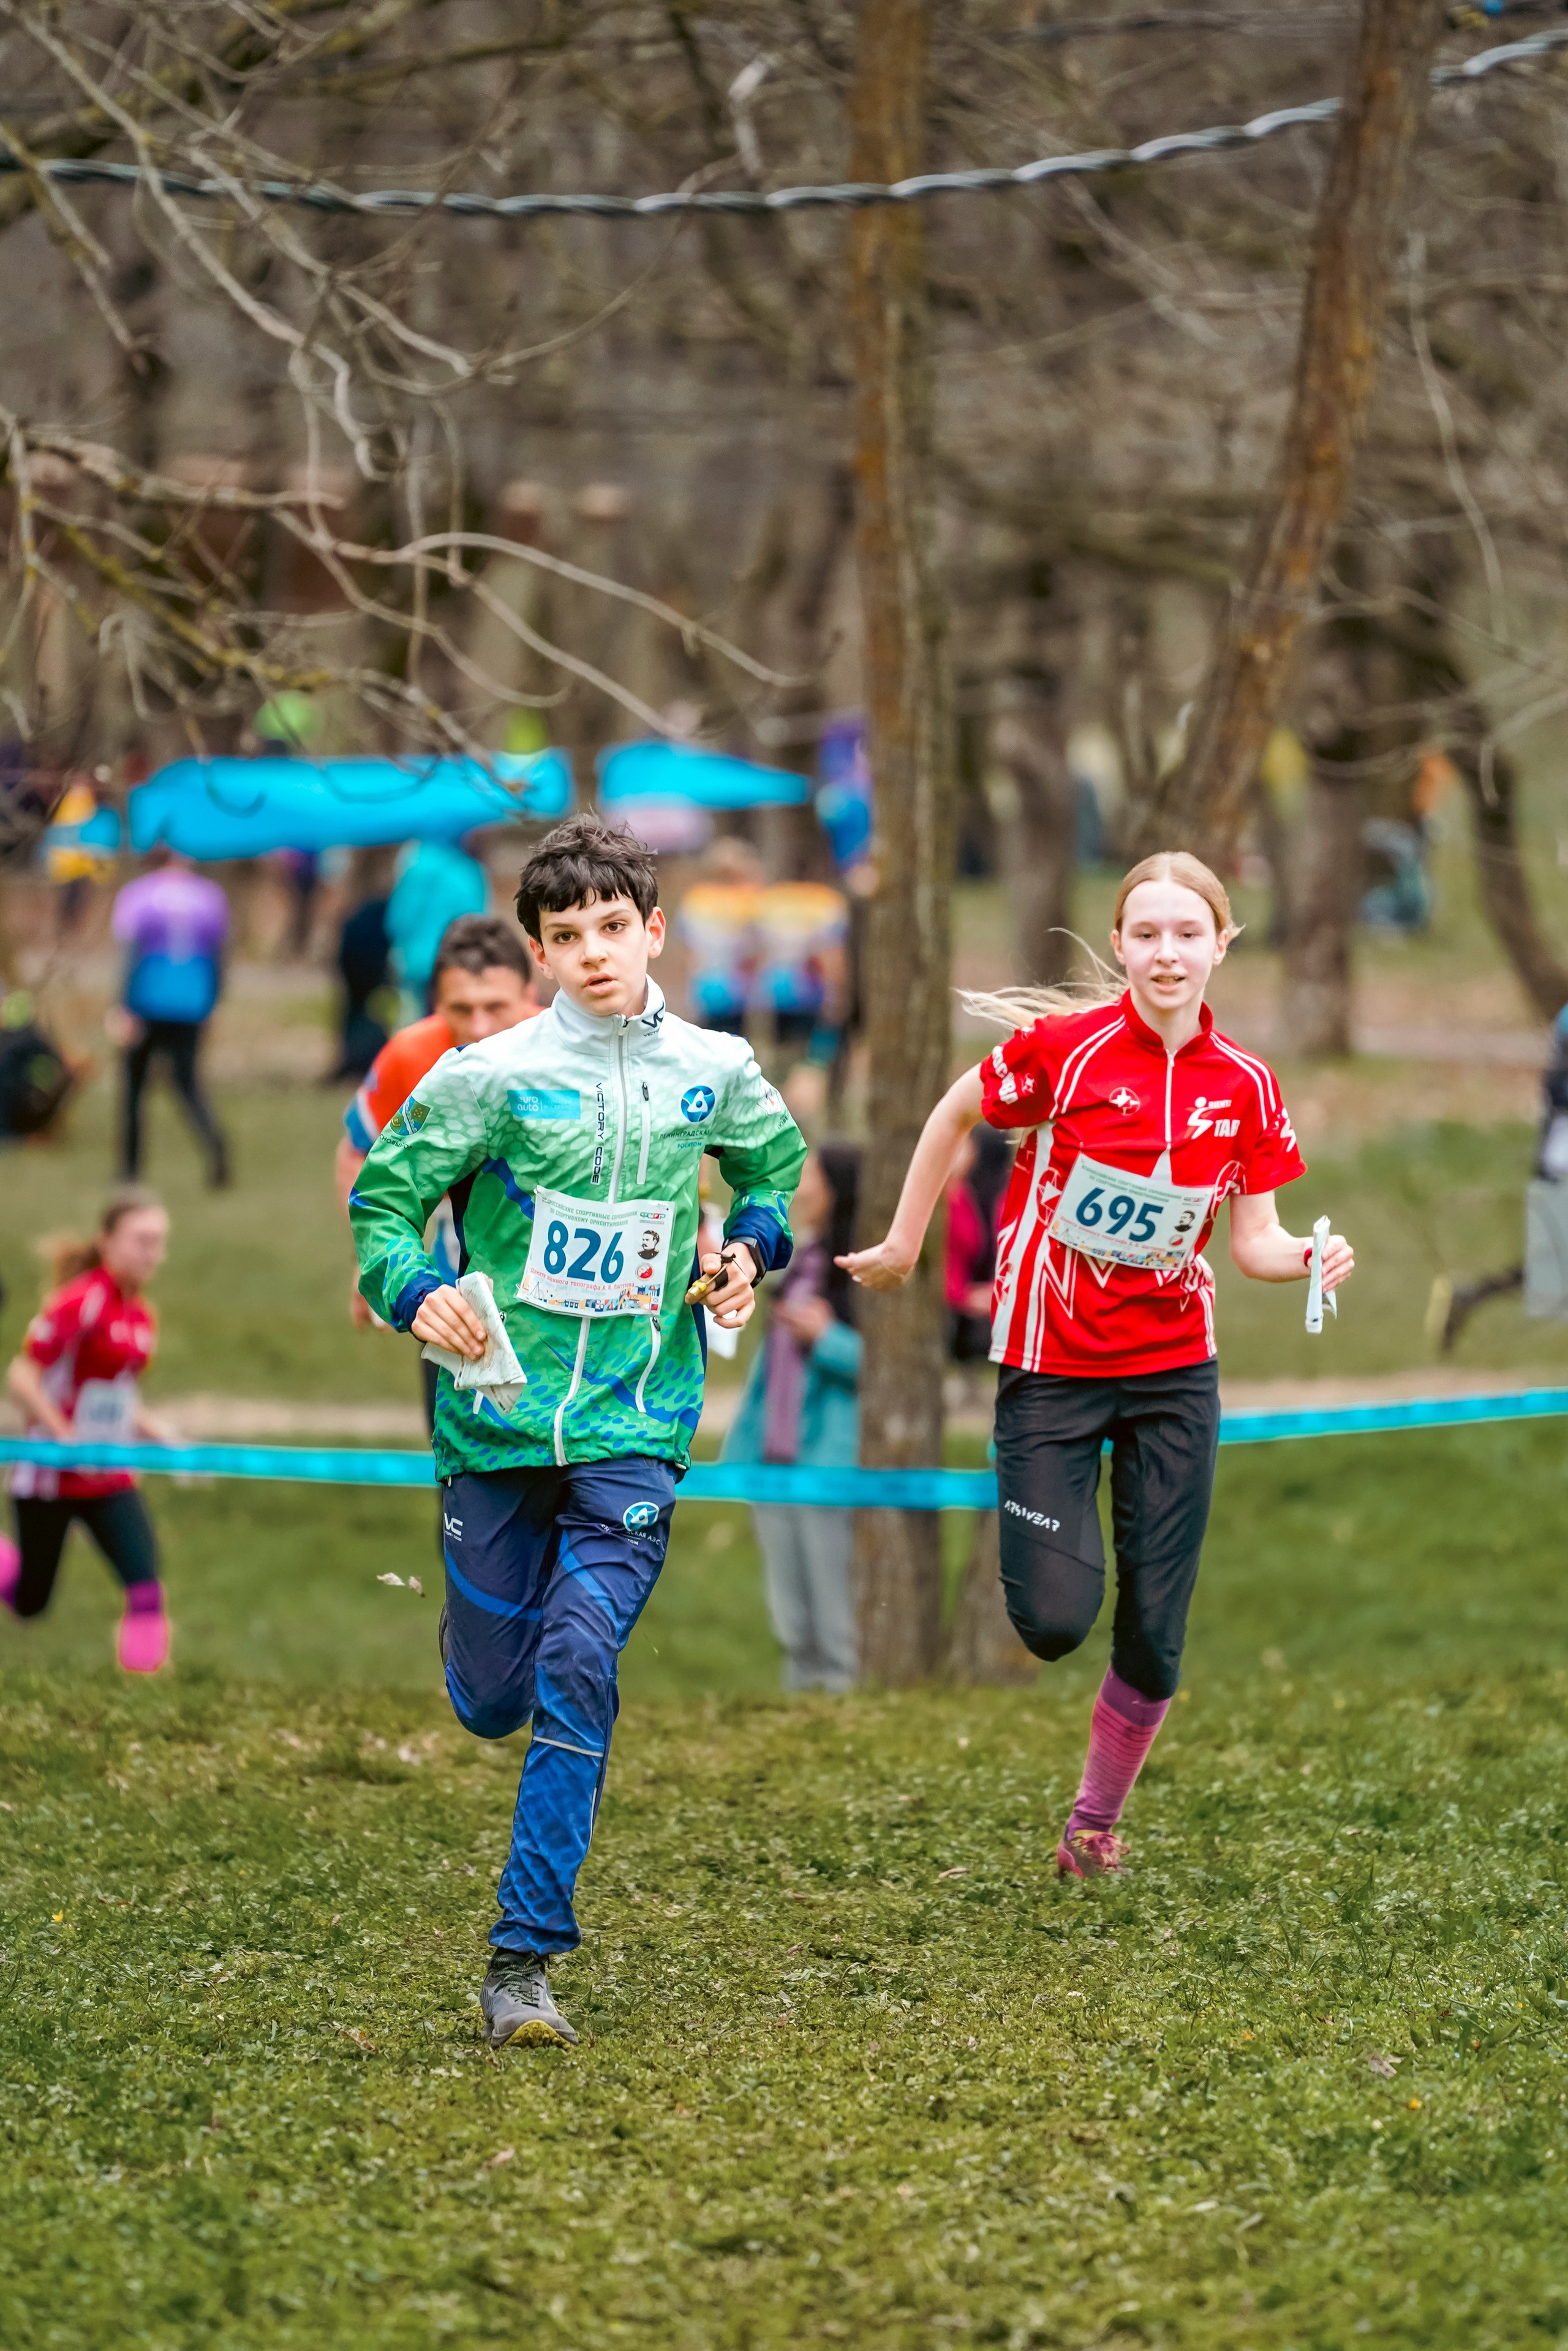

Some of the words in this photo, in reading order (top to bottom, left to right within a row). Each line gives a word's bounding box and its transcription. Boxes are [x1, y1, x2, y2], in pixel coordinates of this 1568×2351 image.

[596, 1082, 605, 1139] VICTORY
[592, 1147, 602, 1183] CODE
[1076, 1187, 1164, 1242] 695
[544, 1220, 624, 1283] 826
[570, 1281, 601, 1291] топографа
